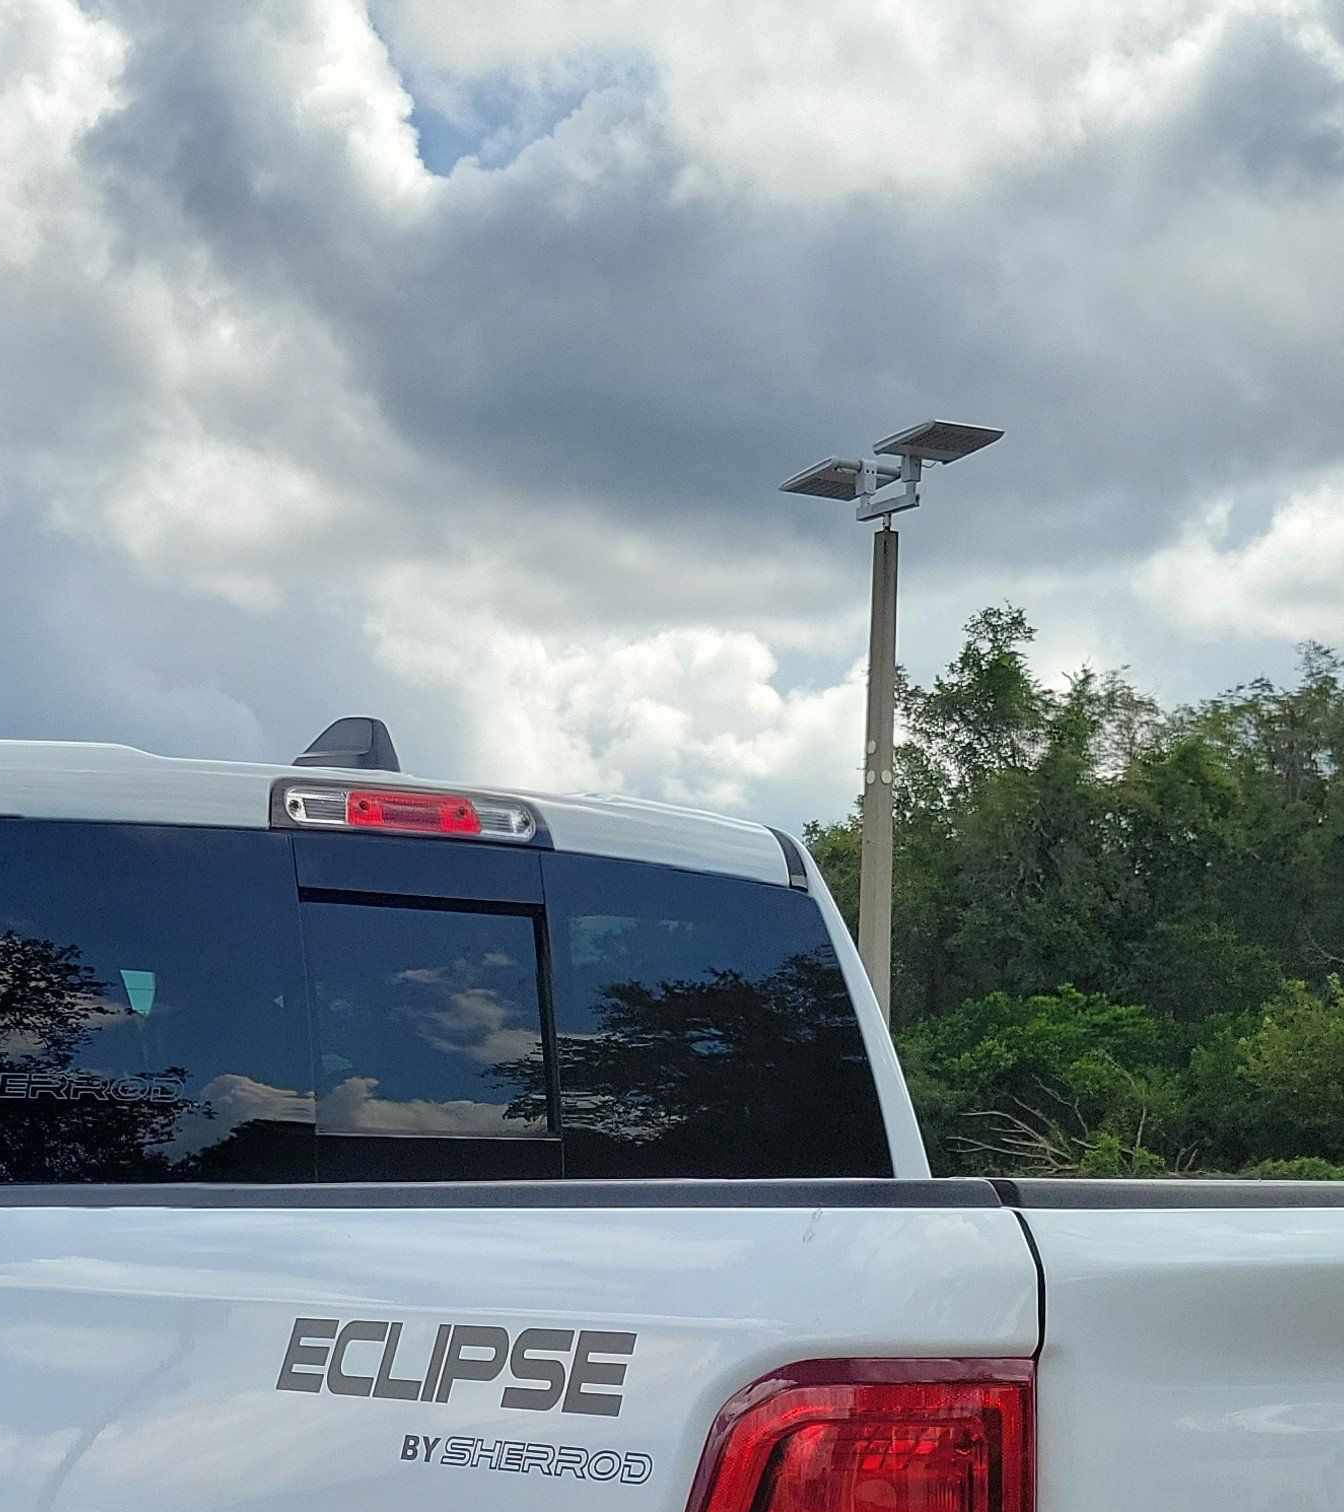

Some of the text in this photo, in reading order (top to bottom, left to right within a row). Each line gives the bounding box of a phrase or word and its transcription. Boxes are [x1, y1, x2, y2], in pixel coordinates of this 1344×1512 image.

[276, 1318, 637, 1417] ECLIPSE
[401, 1435, 653, 1485] BY SHERROD
